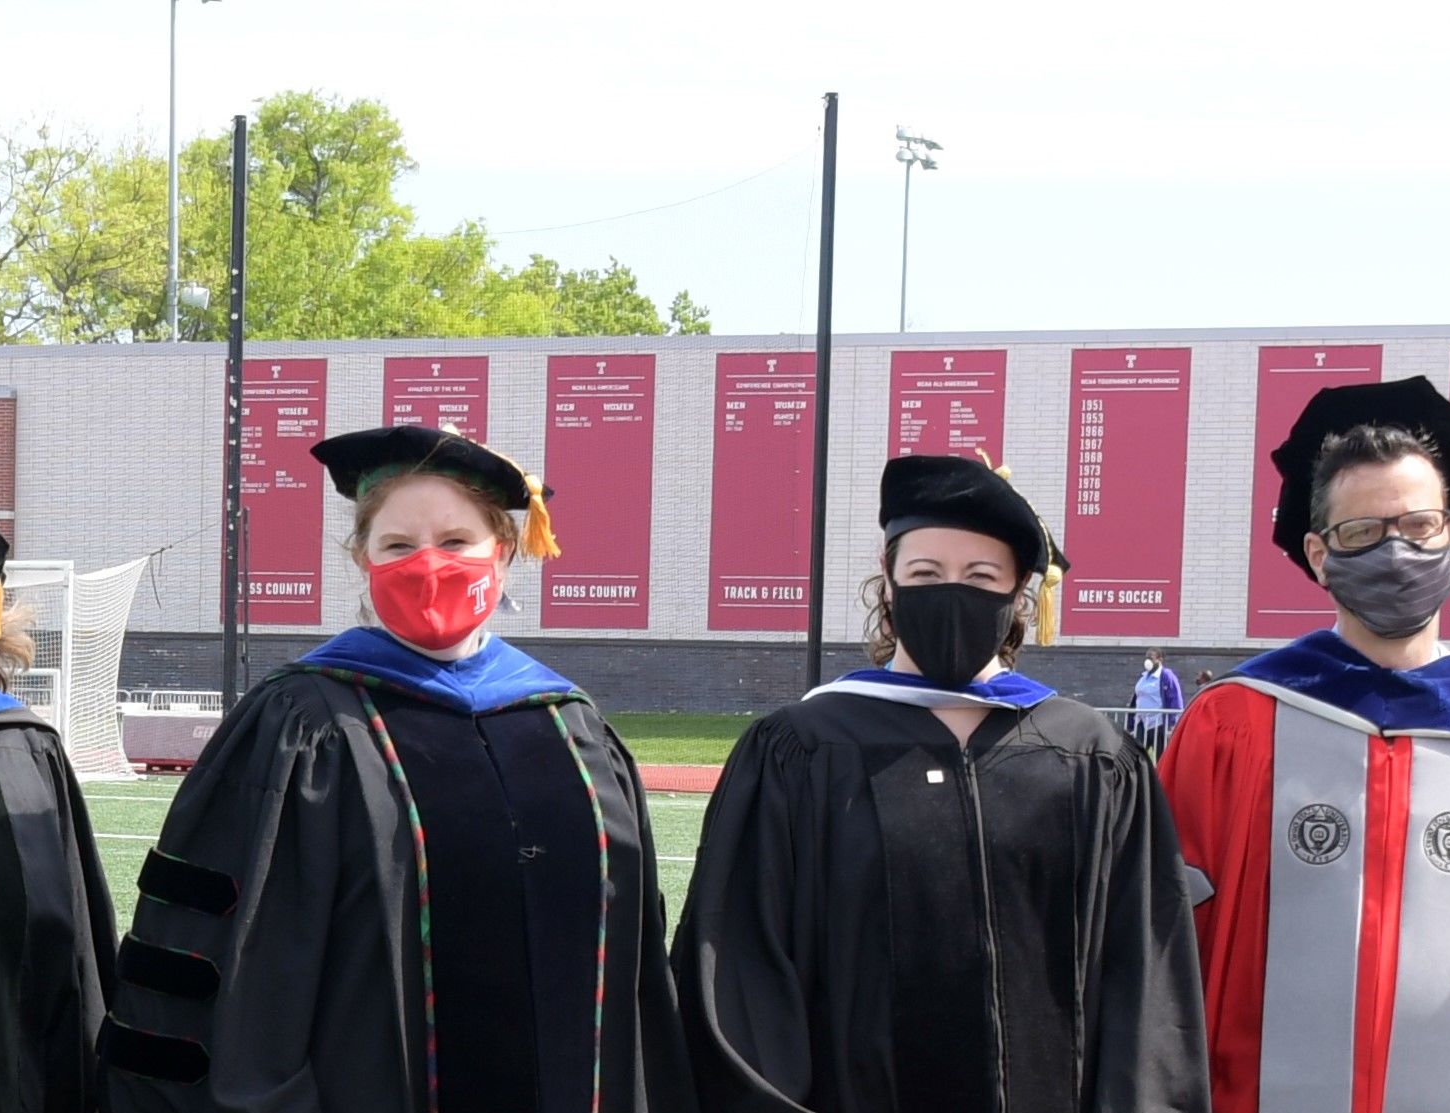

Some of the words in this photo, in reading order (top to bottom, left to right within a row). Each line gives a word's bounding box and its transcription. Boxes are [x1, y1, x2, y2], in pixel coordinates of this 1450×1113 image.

[1081, 400, 1103, 411] 1951
[1081, 412, 1104, 424] 1953
[1080, 426, 1104, 437] 1966
[1080, 438, 1103, 450] 1967
[1079, 464, 1100, 476] 1973
[266, 582, 312, 595] COUNTRY
[552, 585, 586, 598] CROSS
[590, 586, 637, 598] COUNTRY
[724, 586, 758, 600] TRACK
[772, 586, 803, 600] FIELD
[1078, 590, 1114, 604] MEN'S
[1118, 590, 1162, 604] SOCCER
